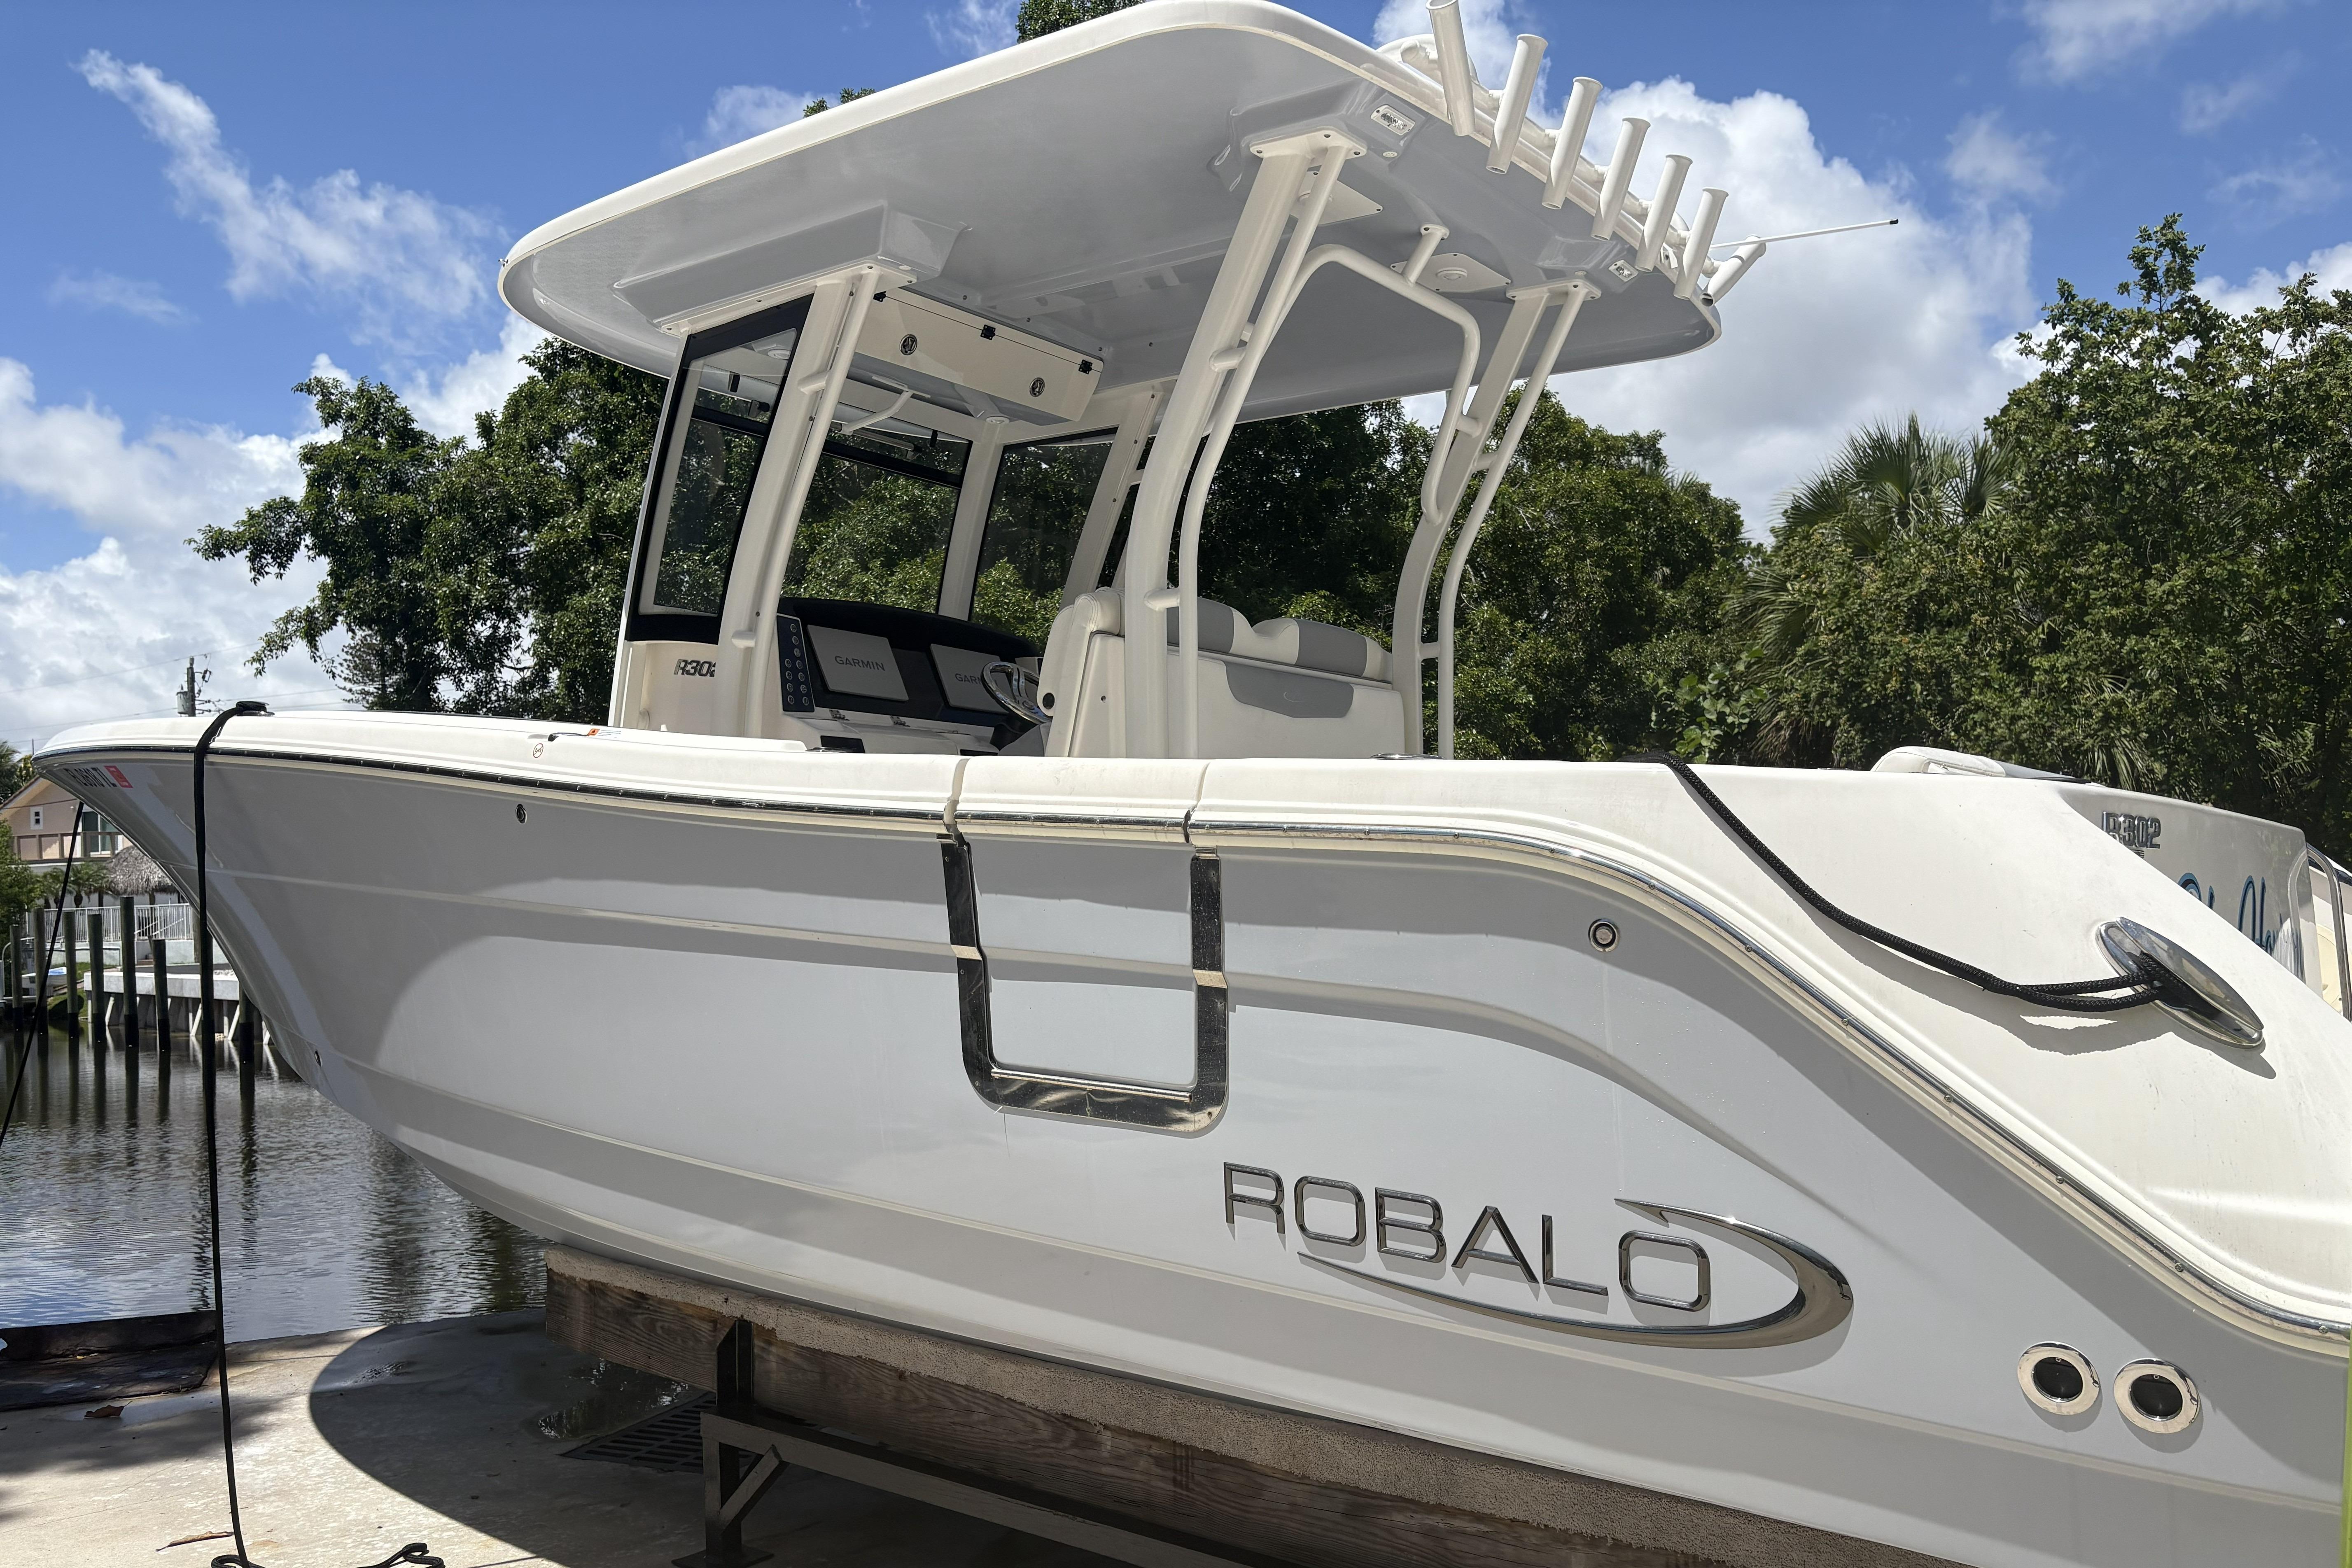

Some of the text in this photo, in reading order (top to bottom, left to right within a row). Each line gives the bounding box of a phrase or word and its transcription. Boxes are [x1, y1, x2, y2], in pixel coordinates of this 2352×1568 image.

[835, 656, 885, 671] GARMIN
[91, 768, 117, 787] TL
[2102, 812, 2161, 849] R302
[1224, 1162, 1710, 1312] ROBALO
